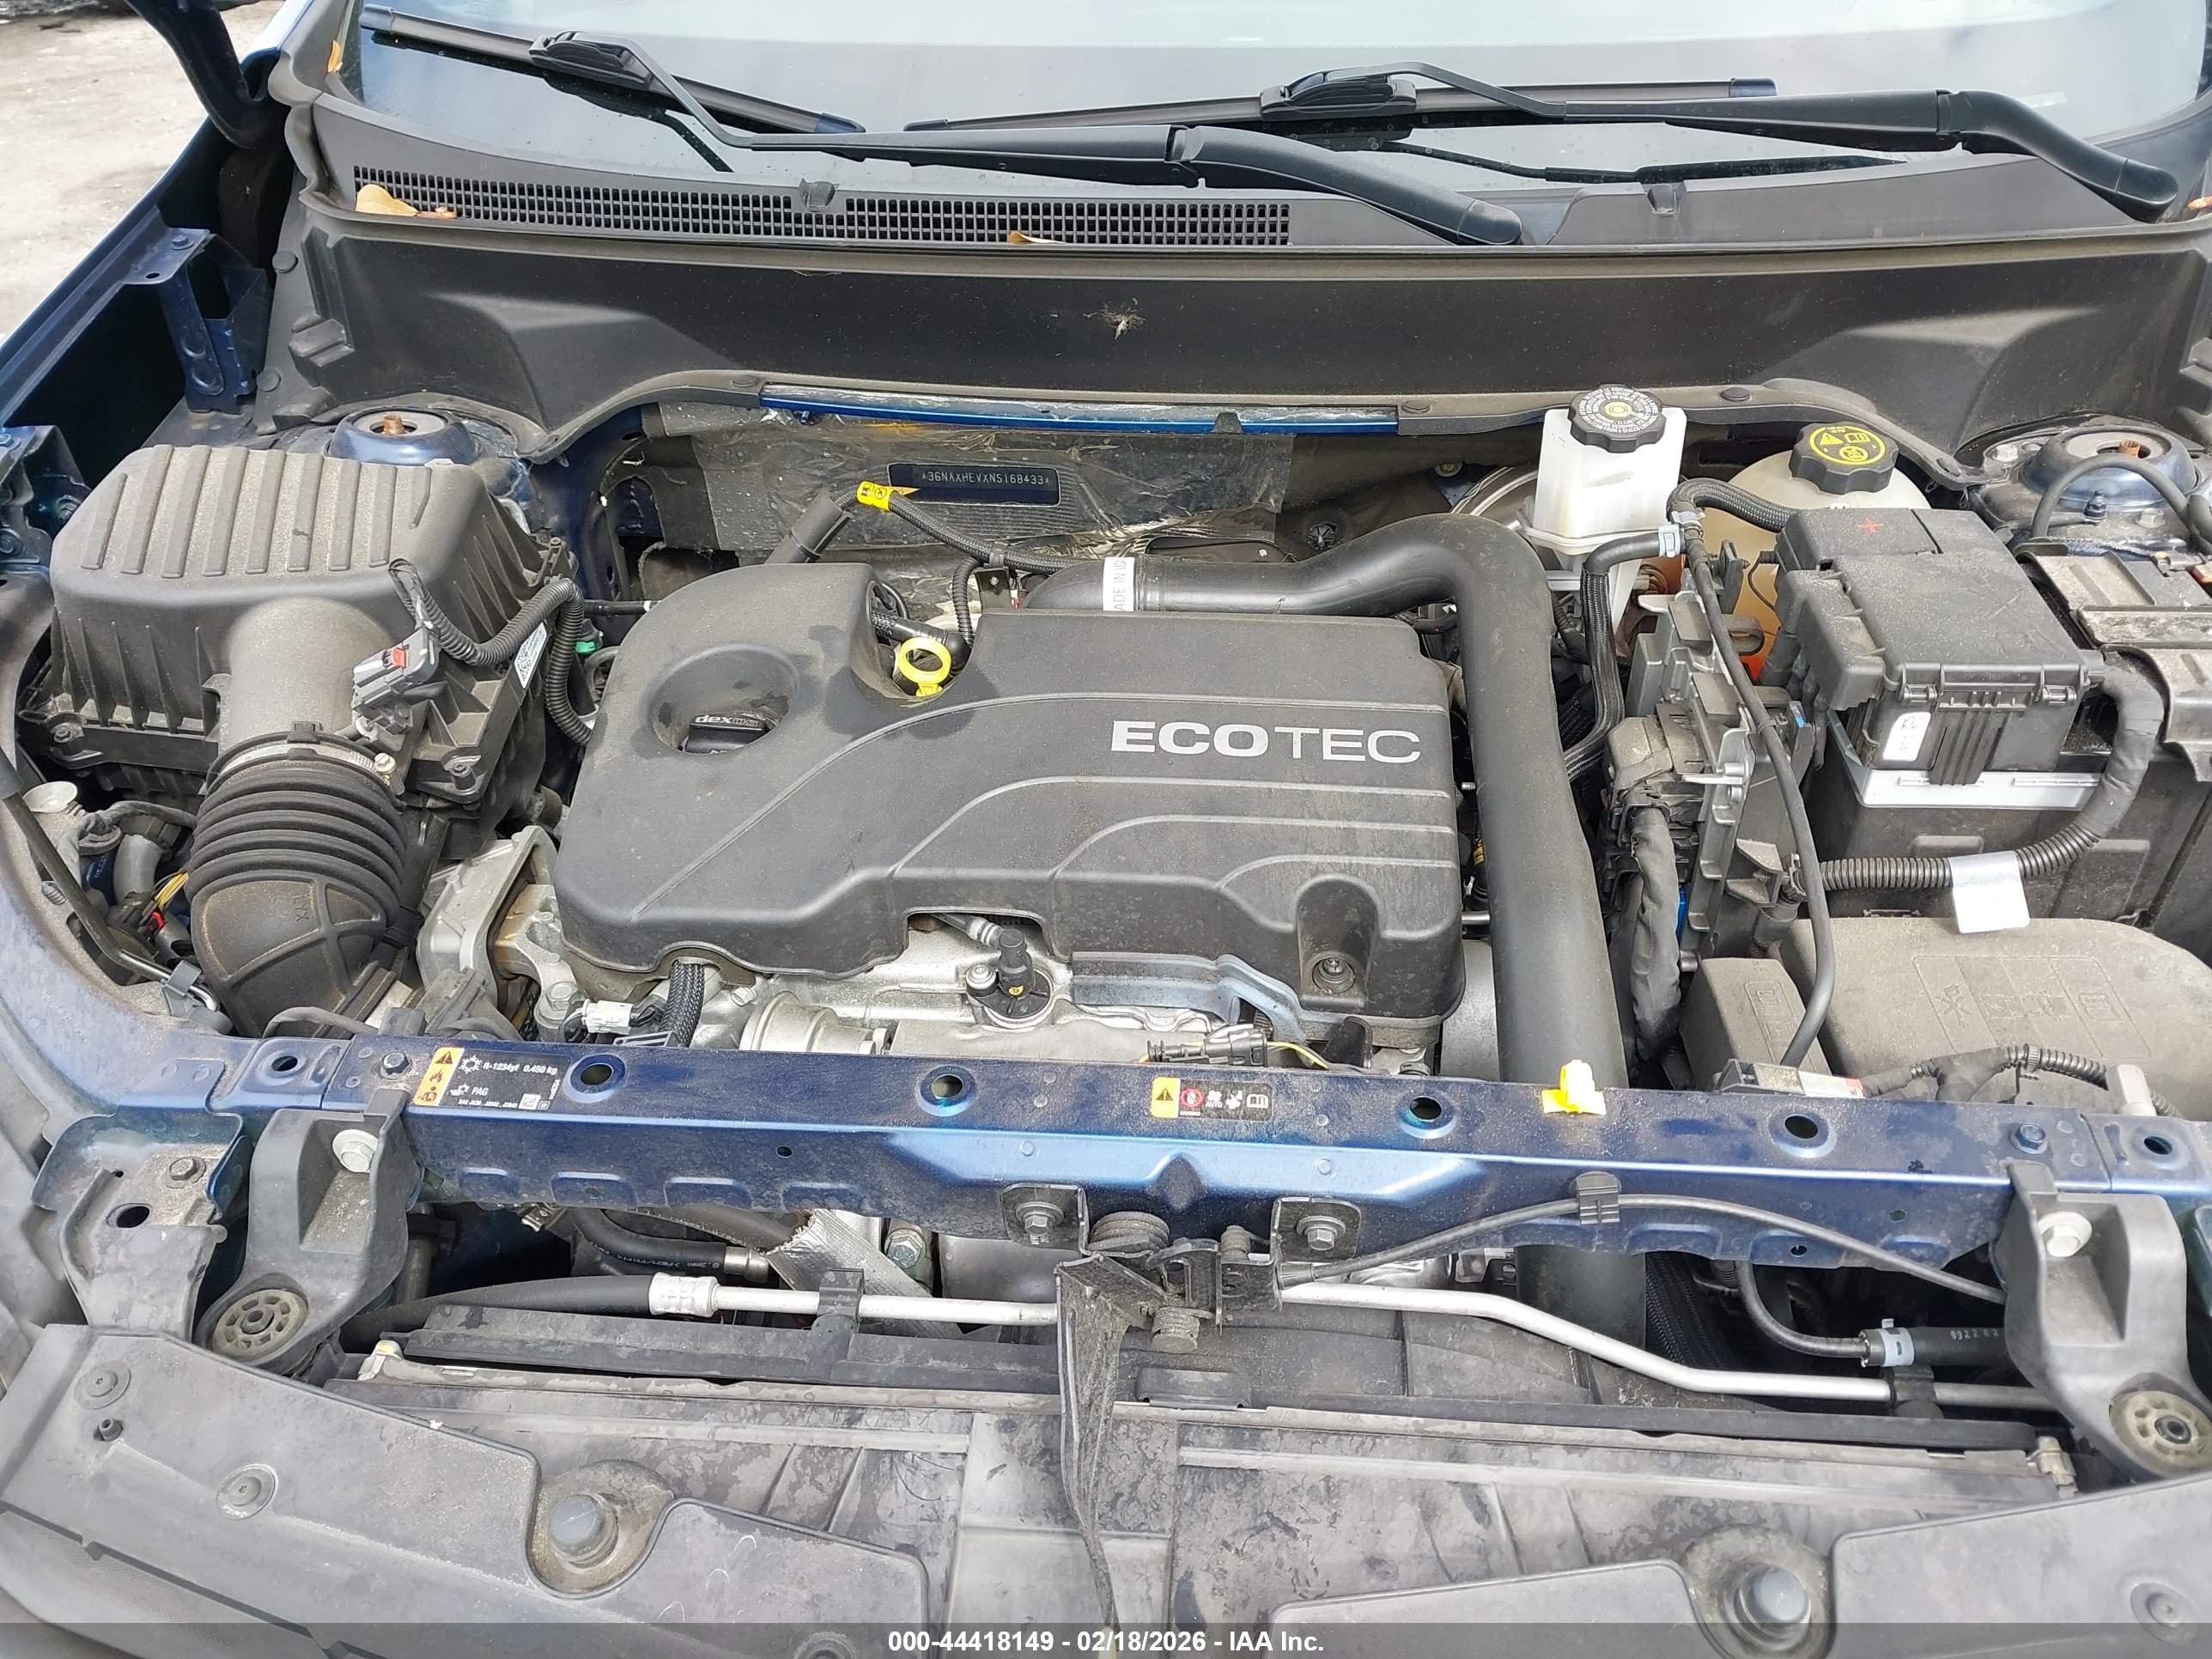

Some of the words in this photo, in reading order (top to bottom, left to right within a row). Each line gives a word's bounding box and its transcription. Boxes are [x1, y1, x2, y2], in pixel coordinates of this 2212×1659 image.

[1113, 586, 1126, 611] ADE
[1111, 720, 1421, 763] ECOTEC
[523, 1064, 546, 1074] 0.450
[546, 1066, 558, 1076] kg
[471, 1087, 489, 1097] PAG
[1206, 1100, 1223, 1109] AUTO
